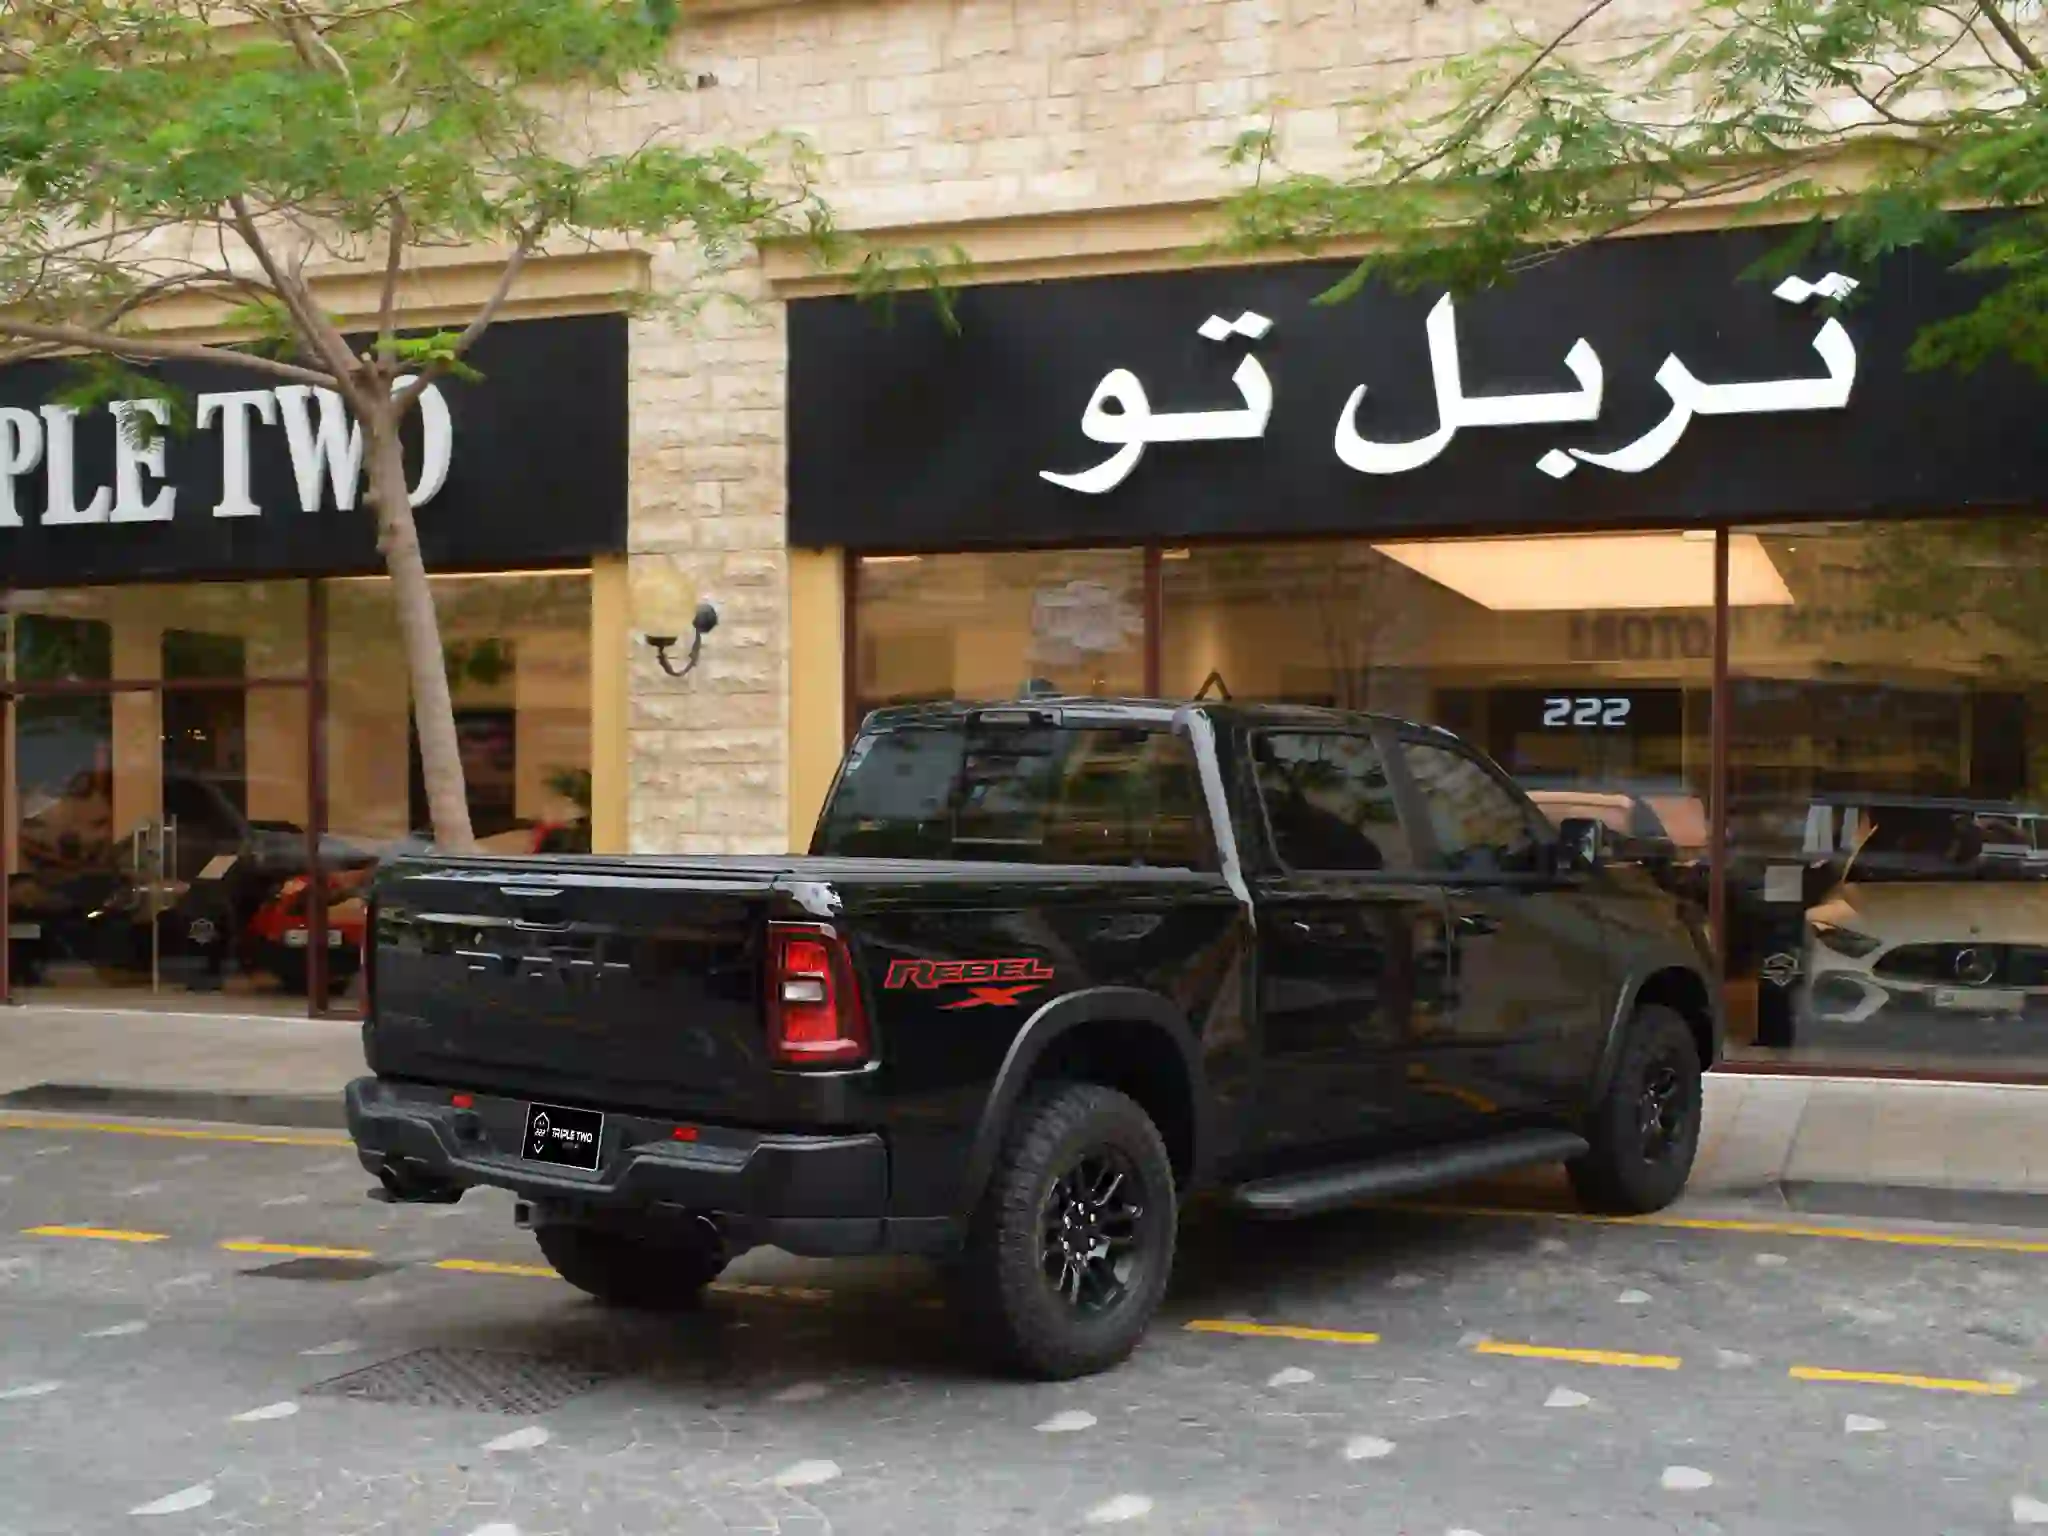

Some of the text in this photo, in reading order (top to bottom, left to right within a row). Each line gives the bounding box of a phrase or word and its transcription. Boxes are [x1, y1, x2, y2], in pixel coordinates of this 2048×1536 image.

[1040, 272, 1859, 493] تربل تو
[1543, 697, 1631, 726] 222
[883, 957, 1054, 989] REBEL
[935, 984, 1043, 1010] X
[551, 1127, 593, 1143] TRIPLE TWO
